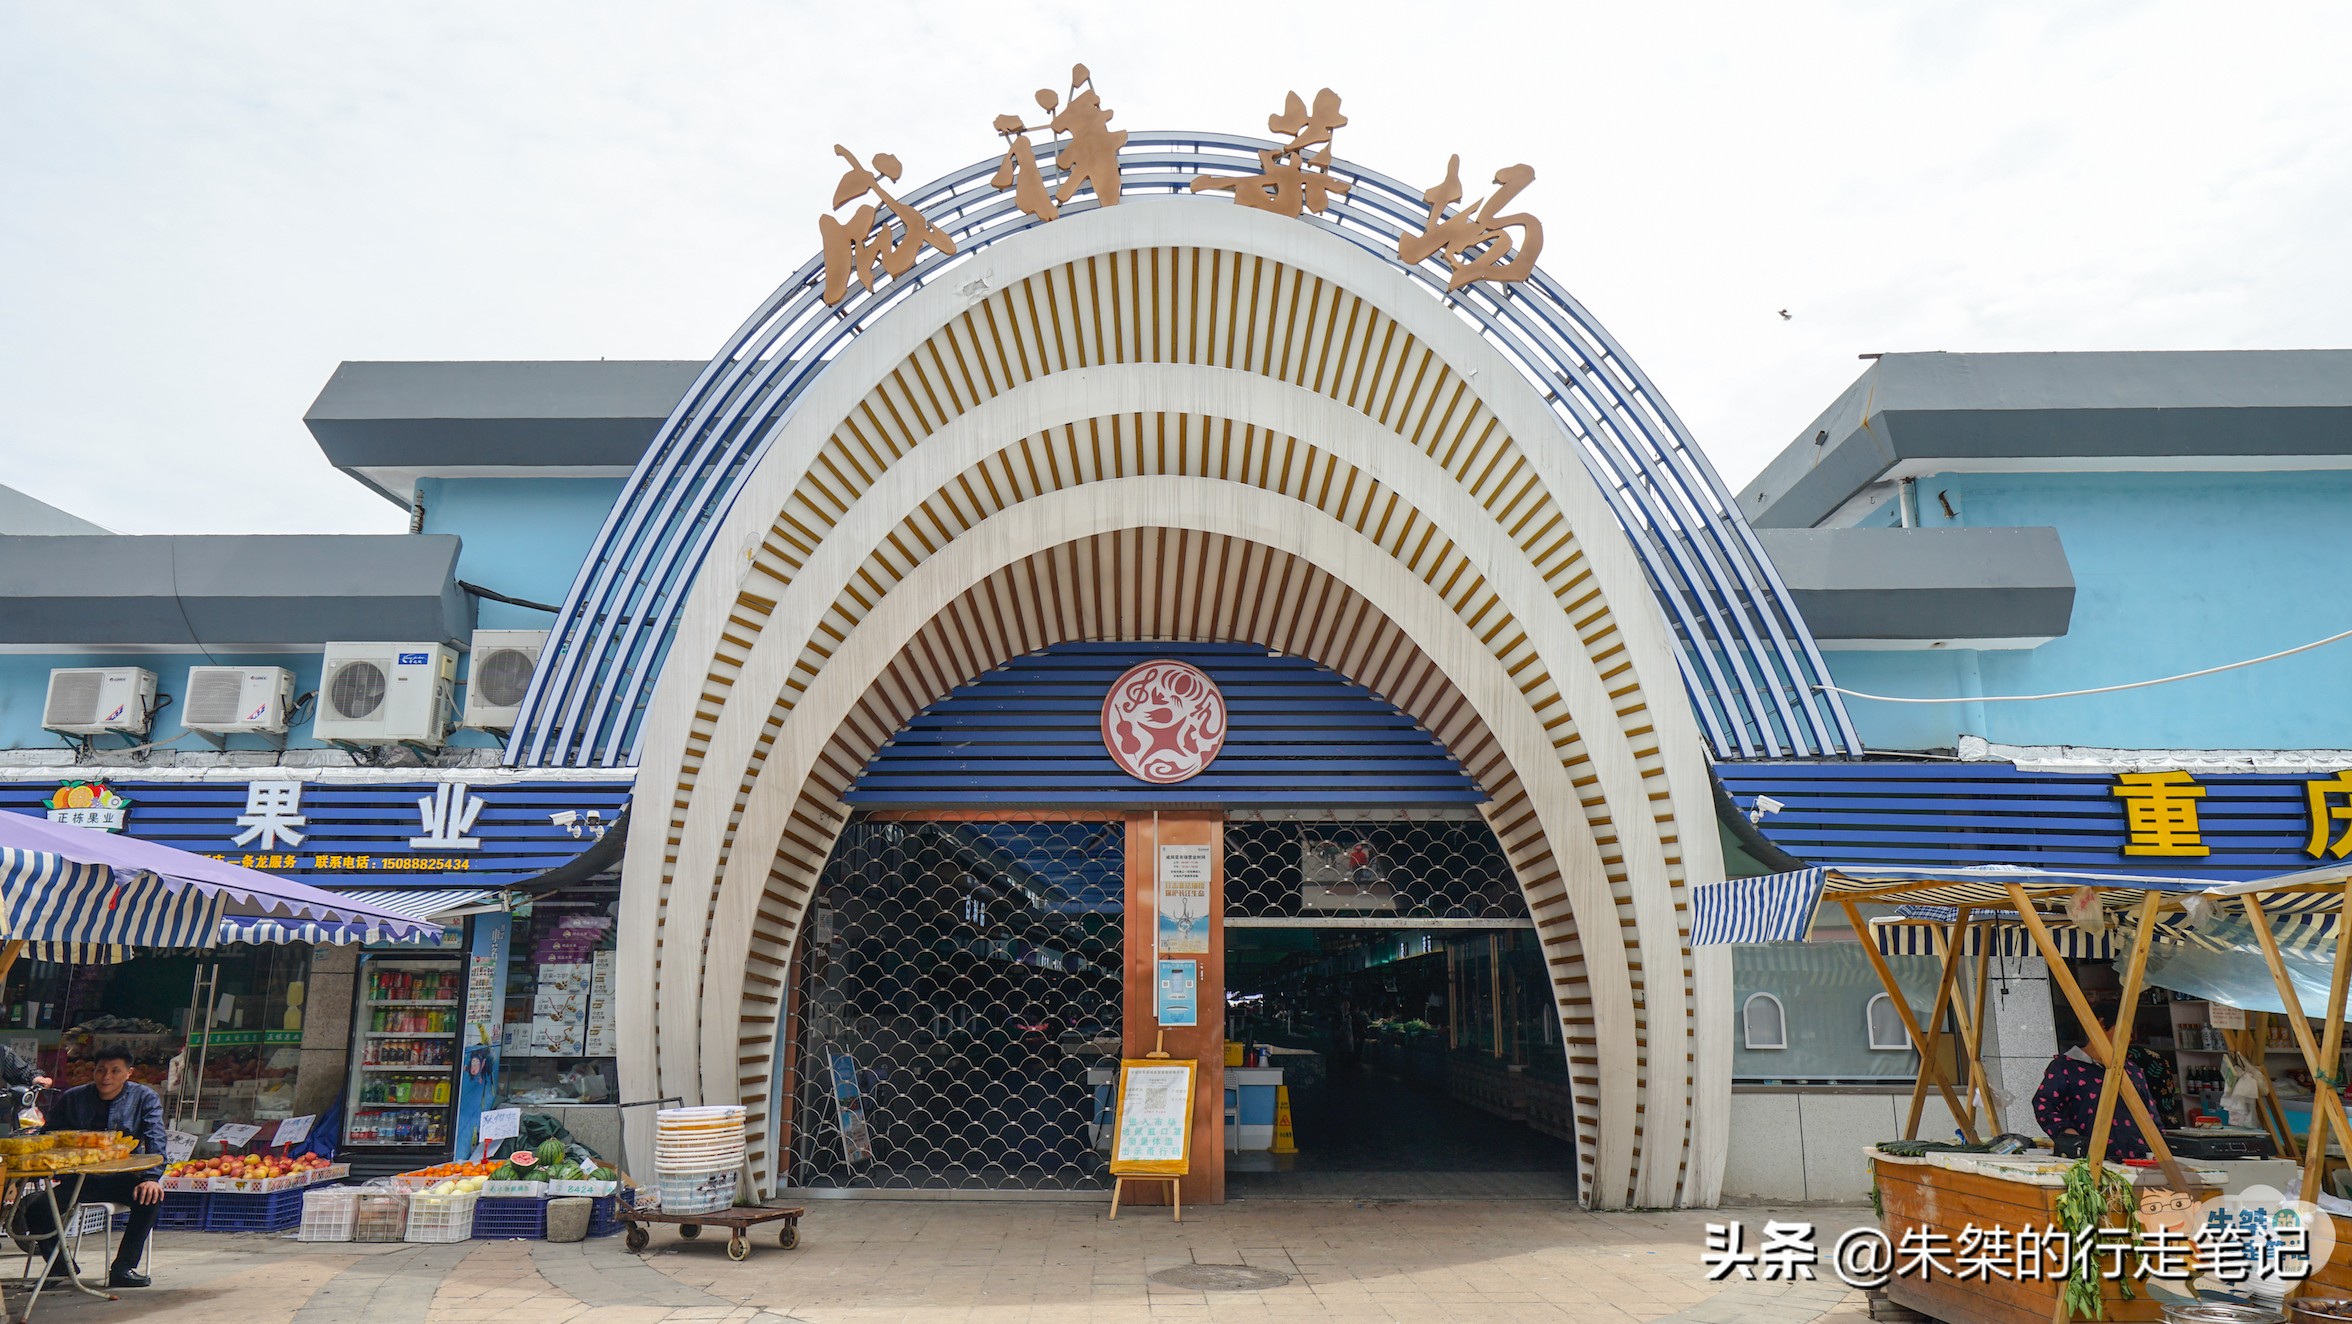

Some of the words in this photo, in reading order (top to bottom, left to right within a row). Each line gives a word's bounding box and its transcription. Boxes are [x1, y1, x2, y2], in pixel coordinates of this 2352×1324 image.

[57, 812, 114, 824] 正栋果业
[231, 780, 486, 850] 果业
[567, 1185, 594, 1193] 8424
